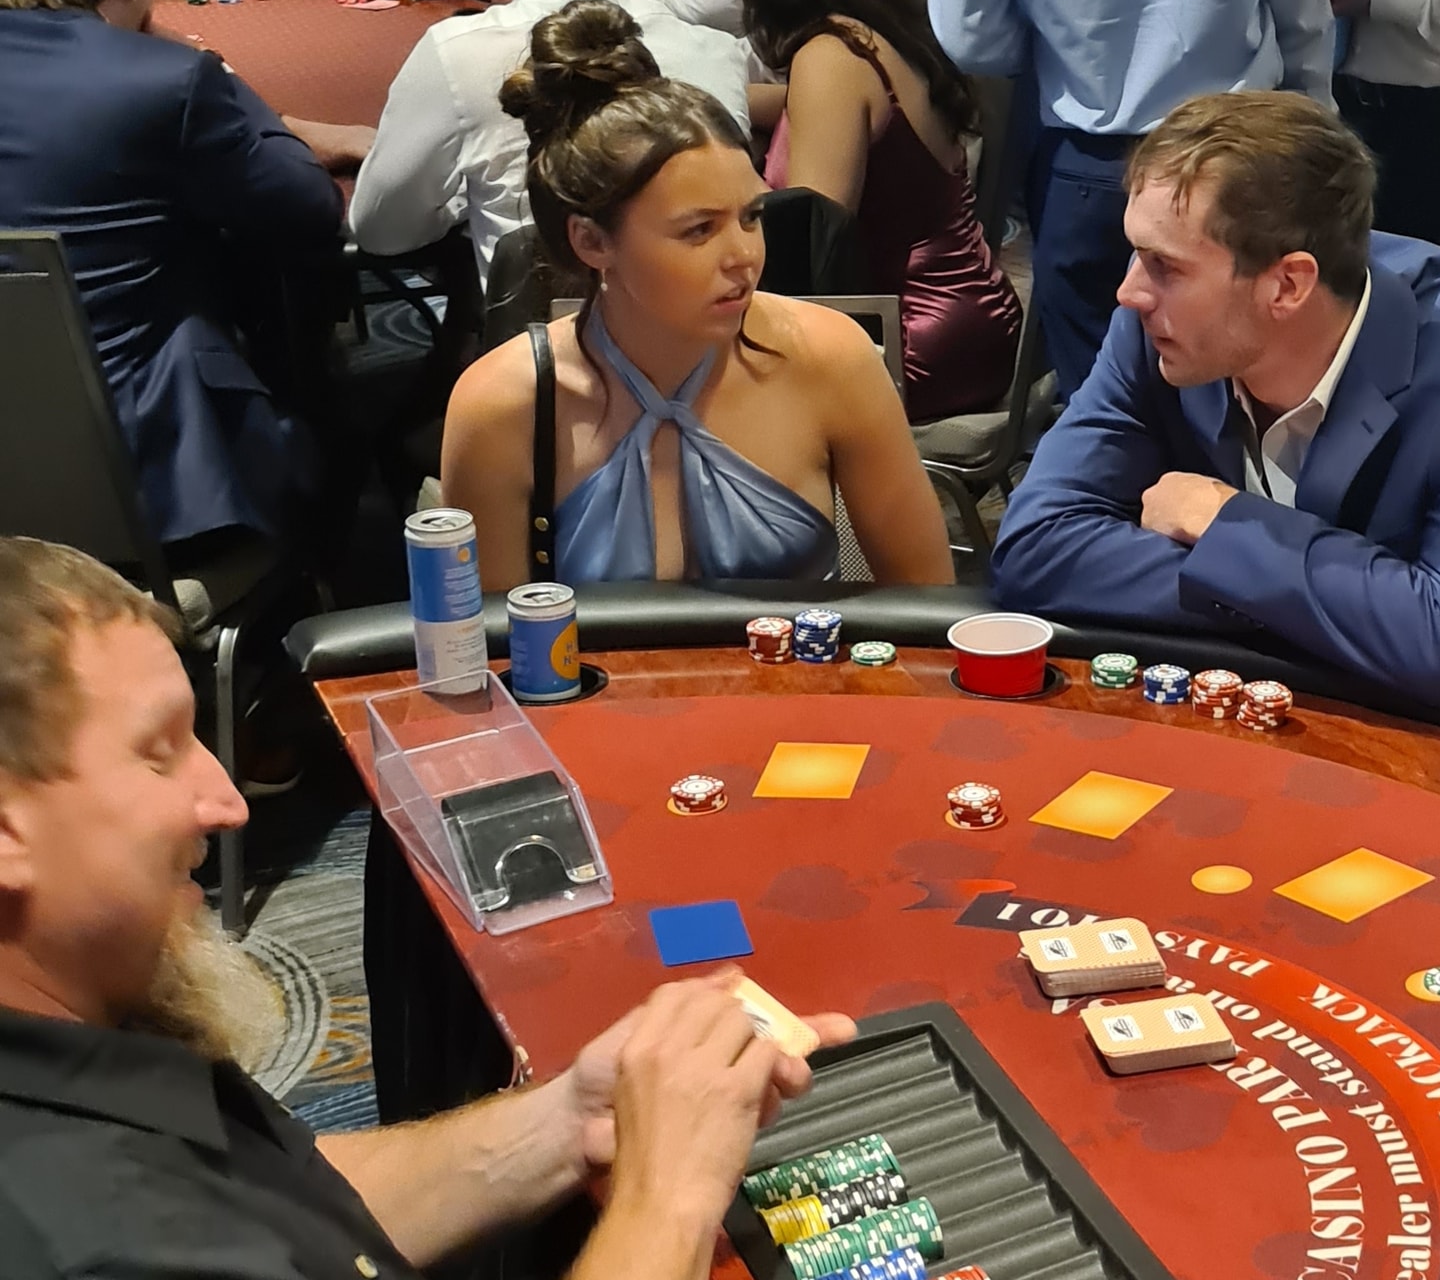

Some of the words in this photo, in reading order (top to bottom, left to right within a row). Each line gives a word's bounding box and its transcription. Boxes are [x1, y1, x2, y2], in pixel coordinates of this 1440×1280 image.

[1154, 930, 1275, 979] PAYS
[1203, 989, 1261, 1022] on
[1251, 1018, 1371, 1097] stand
[1348, 1100, 1425, 1188] must
